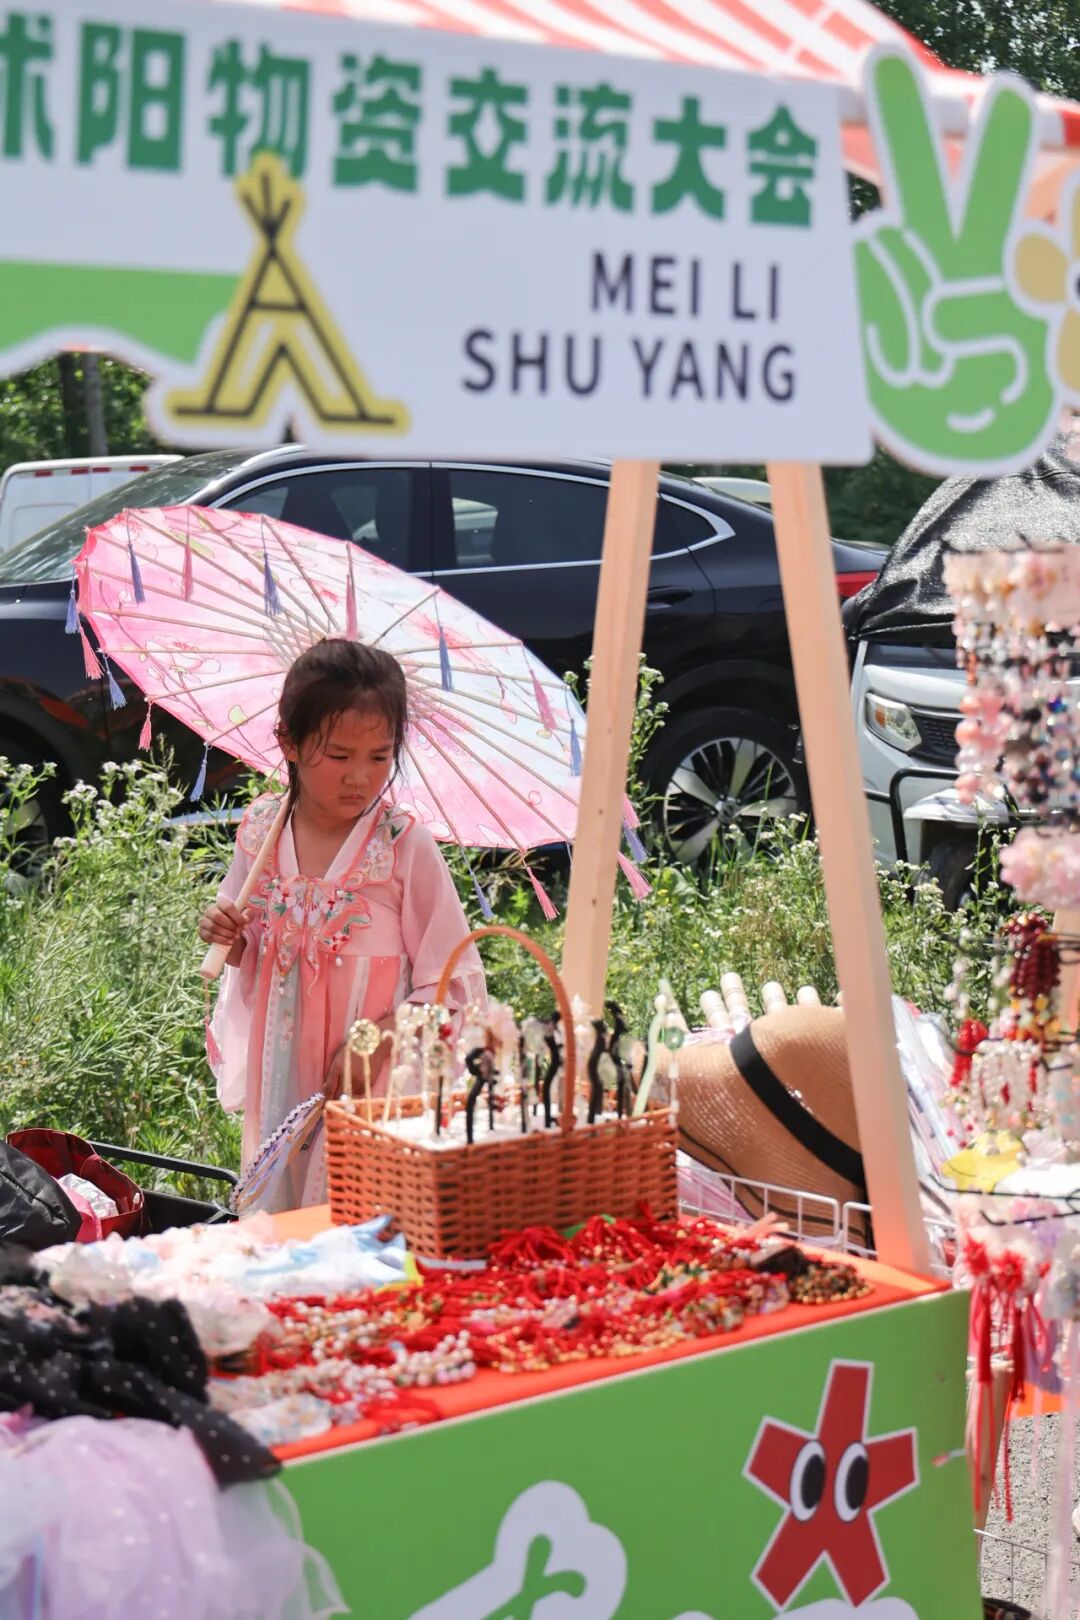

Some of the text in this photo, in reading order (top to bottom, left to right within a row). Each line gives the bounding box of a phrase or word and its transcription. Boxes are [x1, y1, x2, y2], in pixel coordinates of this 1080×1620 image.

[591, 250, 780, 322] MEI LI
[462, 327, 797, 404] SHU YANG
